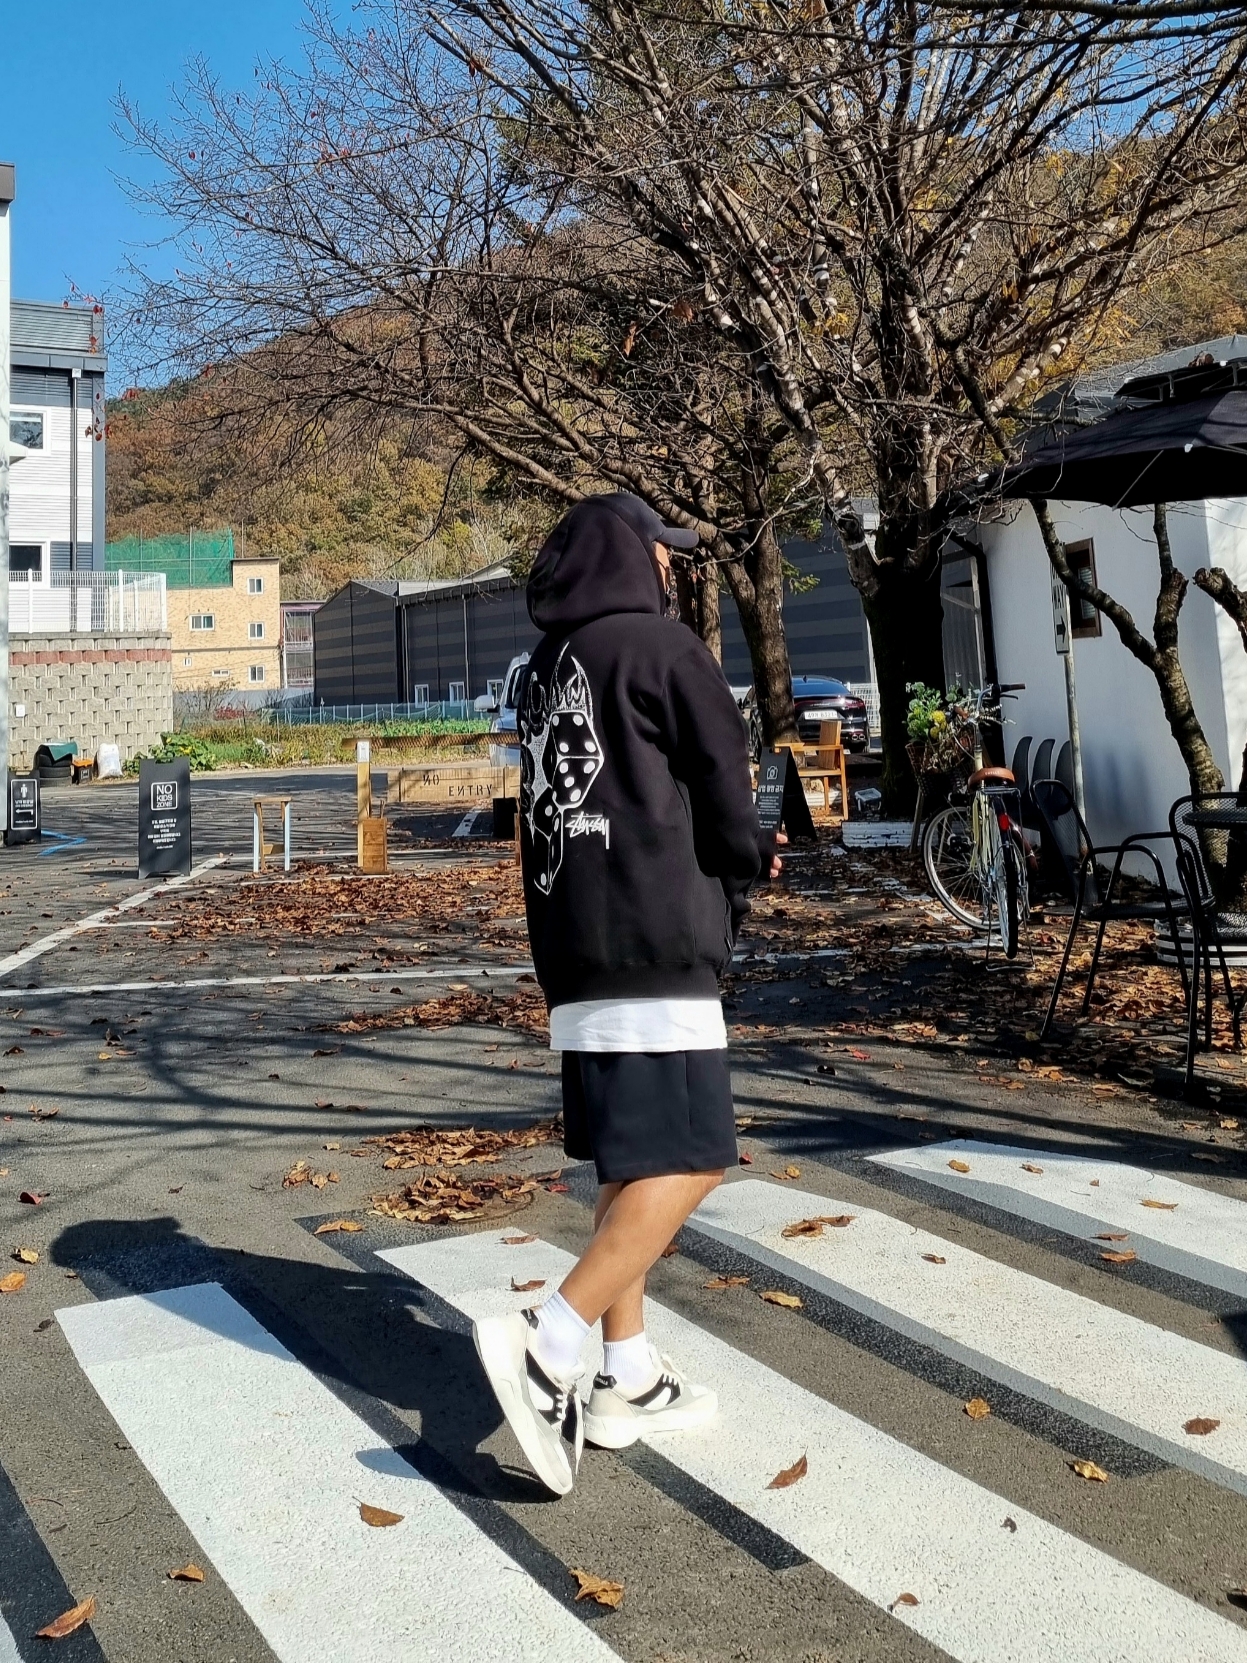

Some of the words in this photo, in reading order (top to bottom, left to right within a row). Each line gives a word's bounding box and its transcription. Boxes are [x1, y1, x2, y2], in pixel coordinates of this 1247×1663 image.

[156, 784, 173, 795] NO
[448, 784, 493, 797] ENTRY
[156, 794, 173, 802] KIDS
